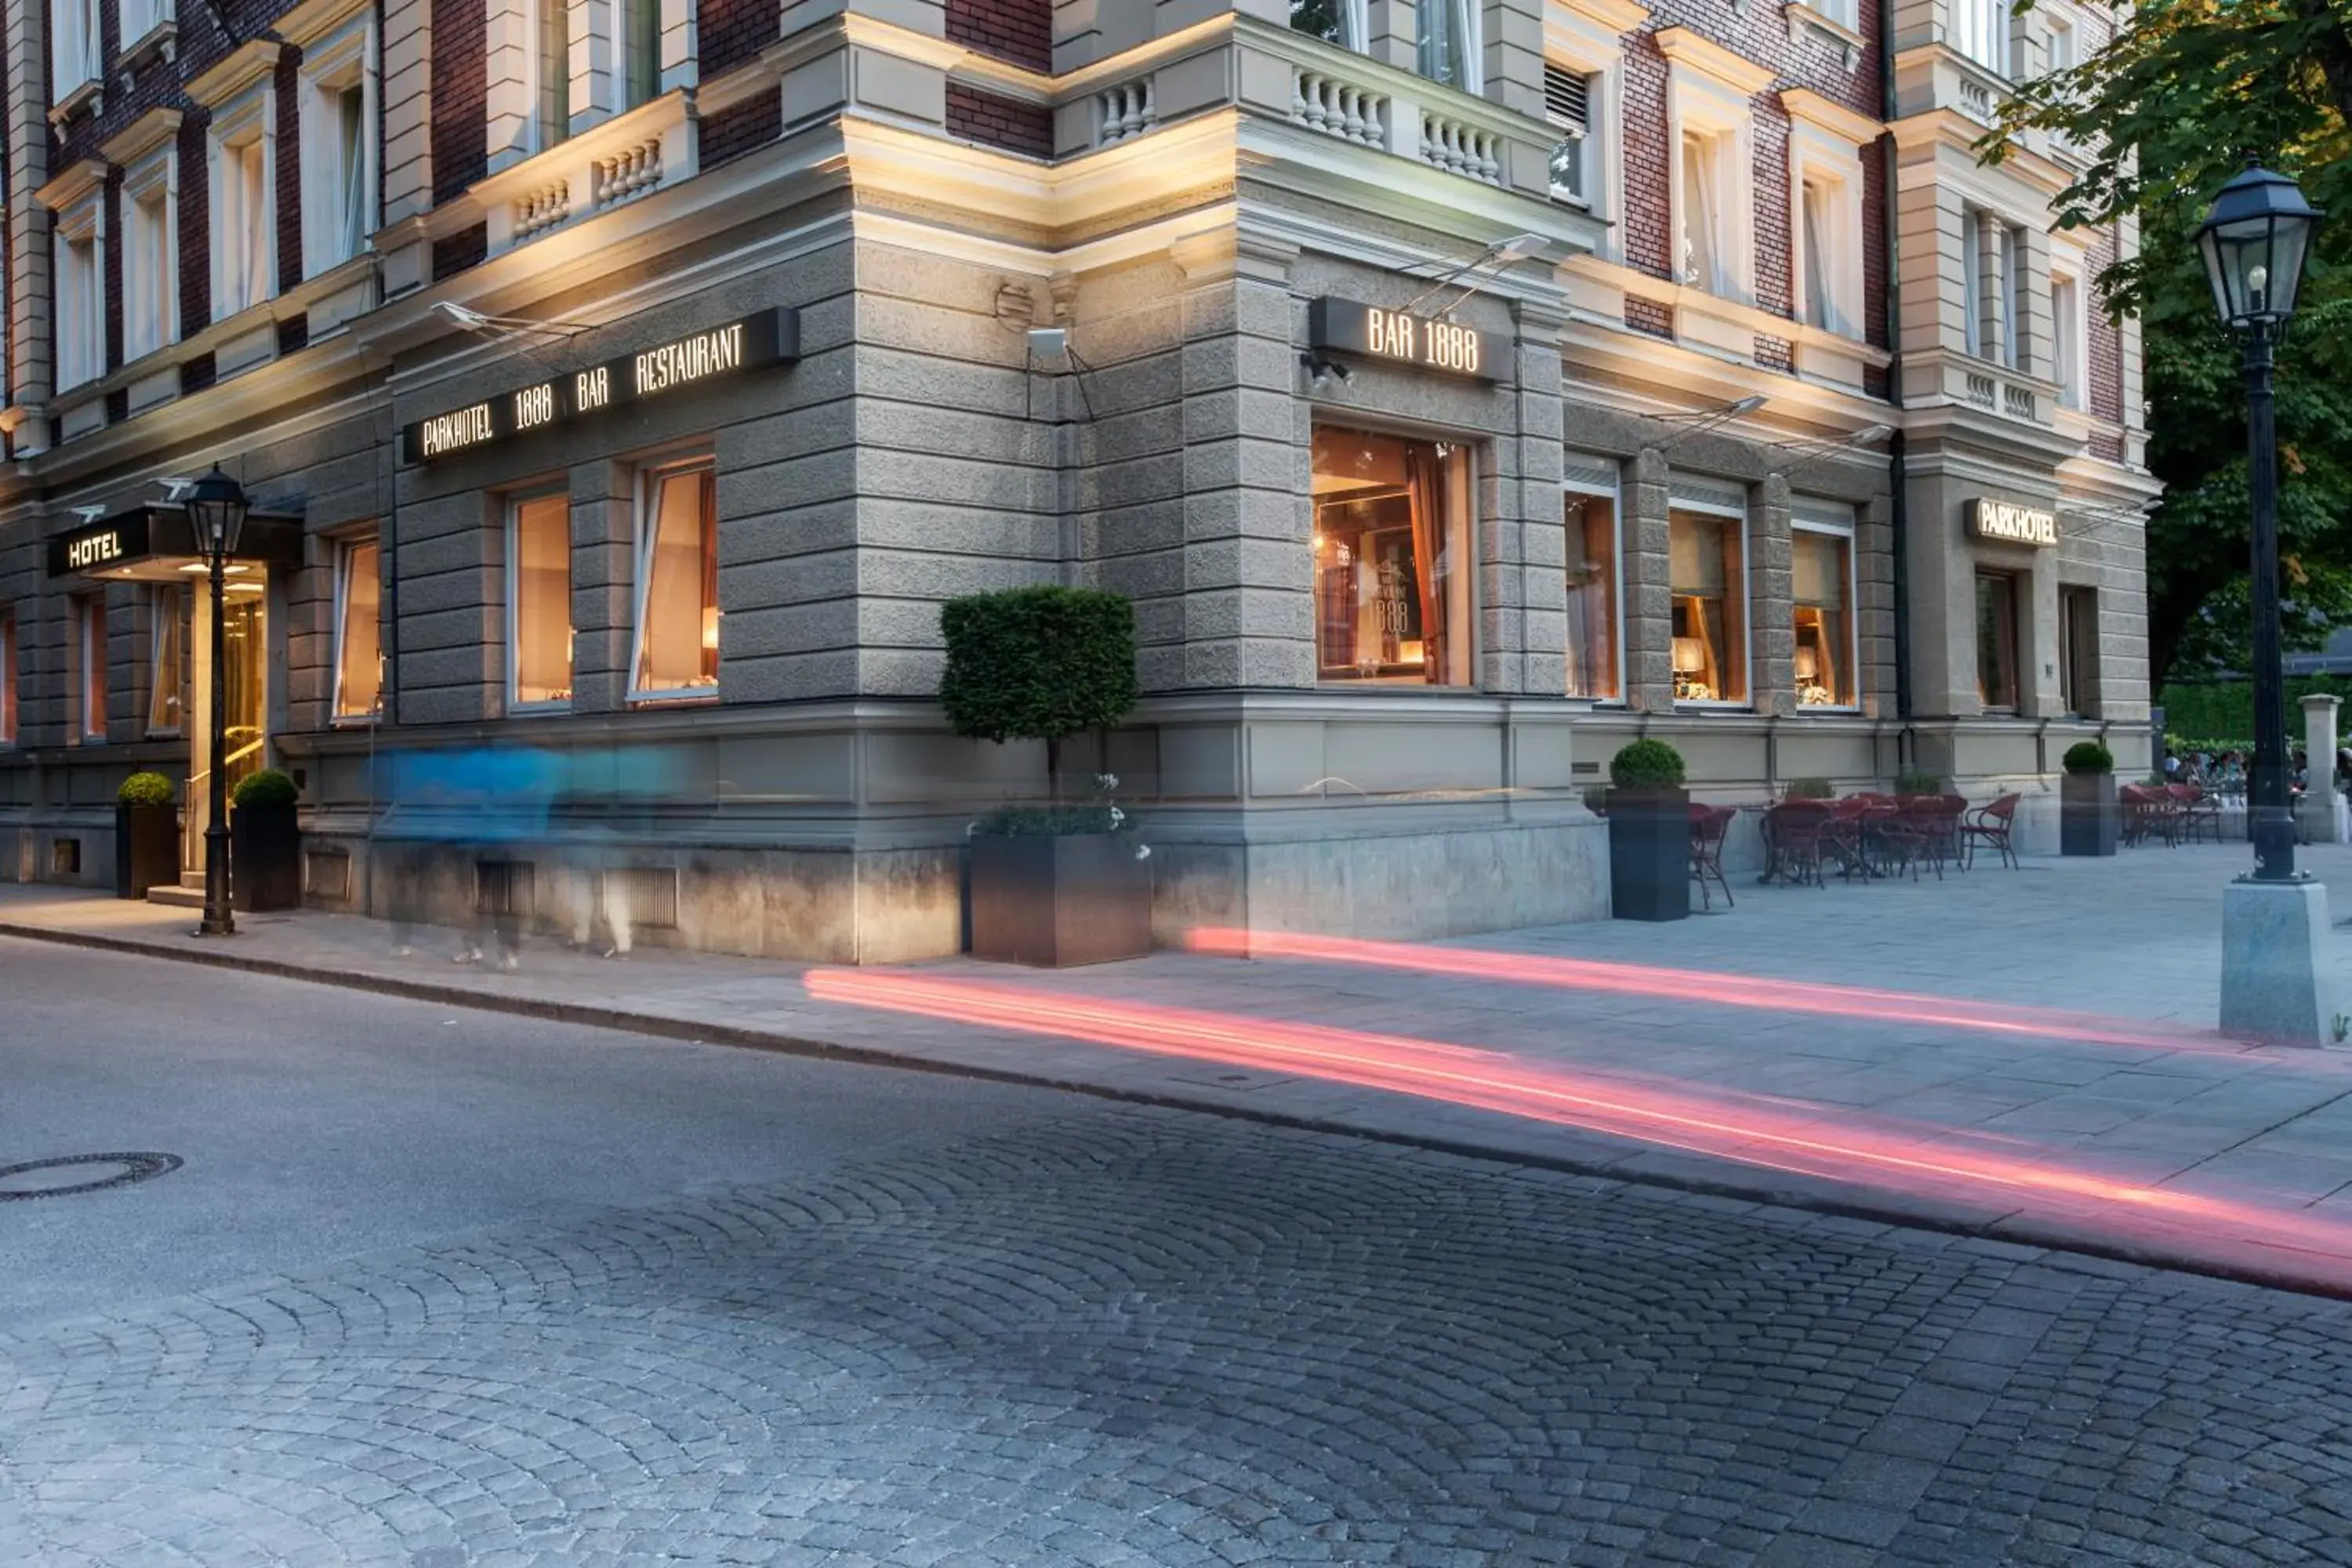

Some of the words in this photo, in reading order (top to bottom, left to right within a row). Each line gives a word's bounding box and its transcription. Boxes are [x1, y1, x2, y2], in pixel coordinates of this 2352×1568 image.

[1368, 307, 1414, 359] BAR
[1425, 320, 1478, 372] 1888
[423, 402, 492, 456] PARKHOTEL
[515, 383, 553, 430] 1888
[577, 366, 608, 412] BAR
[636, 323, 743, 395] RESTAURANT
[69, 531, 123, 568] HOTEL
[1980, 502, 2058, 544] PARKHOTEL
